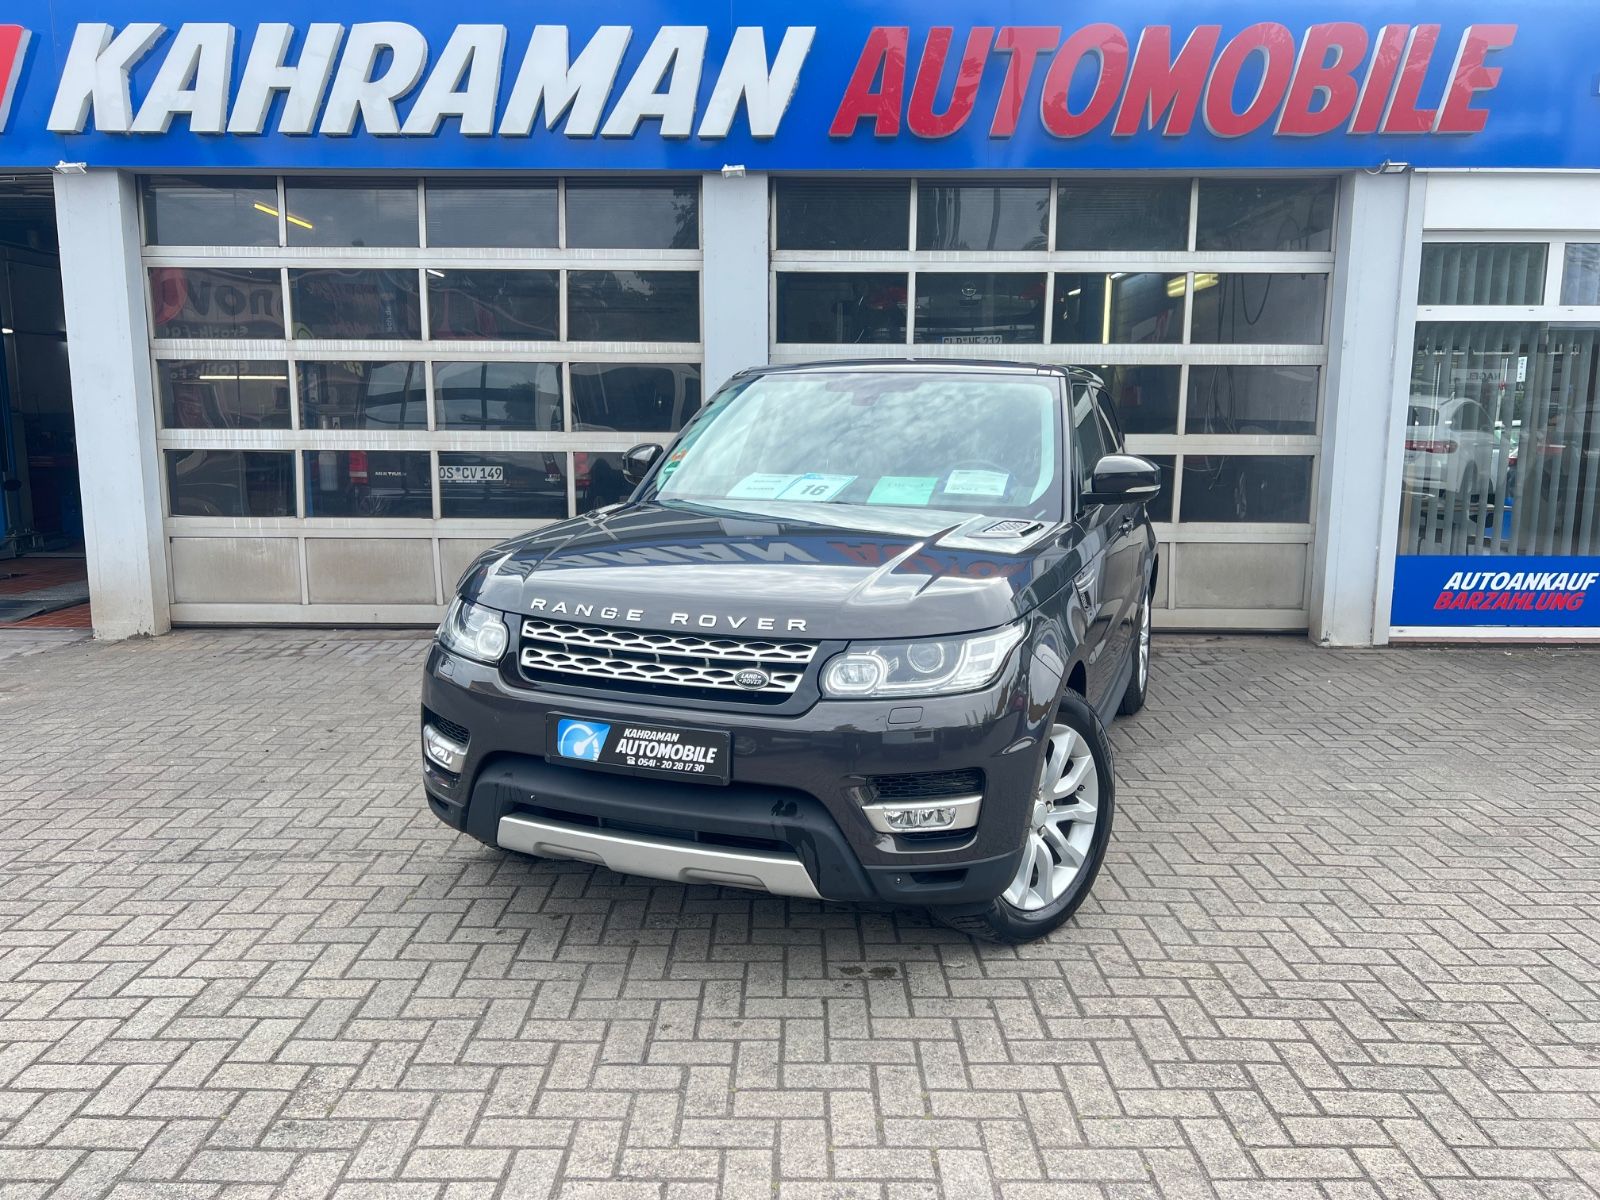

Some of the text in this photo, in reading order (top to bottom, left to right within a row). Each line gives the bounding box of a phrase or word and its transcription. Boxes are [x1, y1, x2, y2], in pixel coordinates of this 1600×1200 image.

[47, 21, 1518, 138] KAHRAMAN AUTOMOBILE
[439, 467, 502, 480] OS CV 149
[800, 484, 829, 496] 16
[1443, 572, 1599, 590] AUTOANKAUF
[1433, 591, 1585, 610] BARZAHLUNG
[530, 598, 807, 632] RANGE ROVER
[623, 728, 680, 743] KAHRAMAN
[615, 738, 718, 764] AUTOMOBILE
[637, 757, 656, 767] 0541
[661, 760, 673, 770] 20
[673, 762, 684, 771] 28
[684, 763, 693, 772] 17
[693, 764, 705, 773] 30
